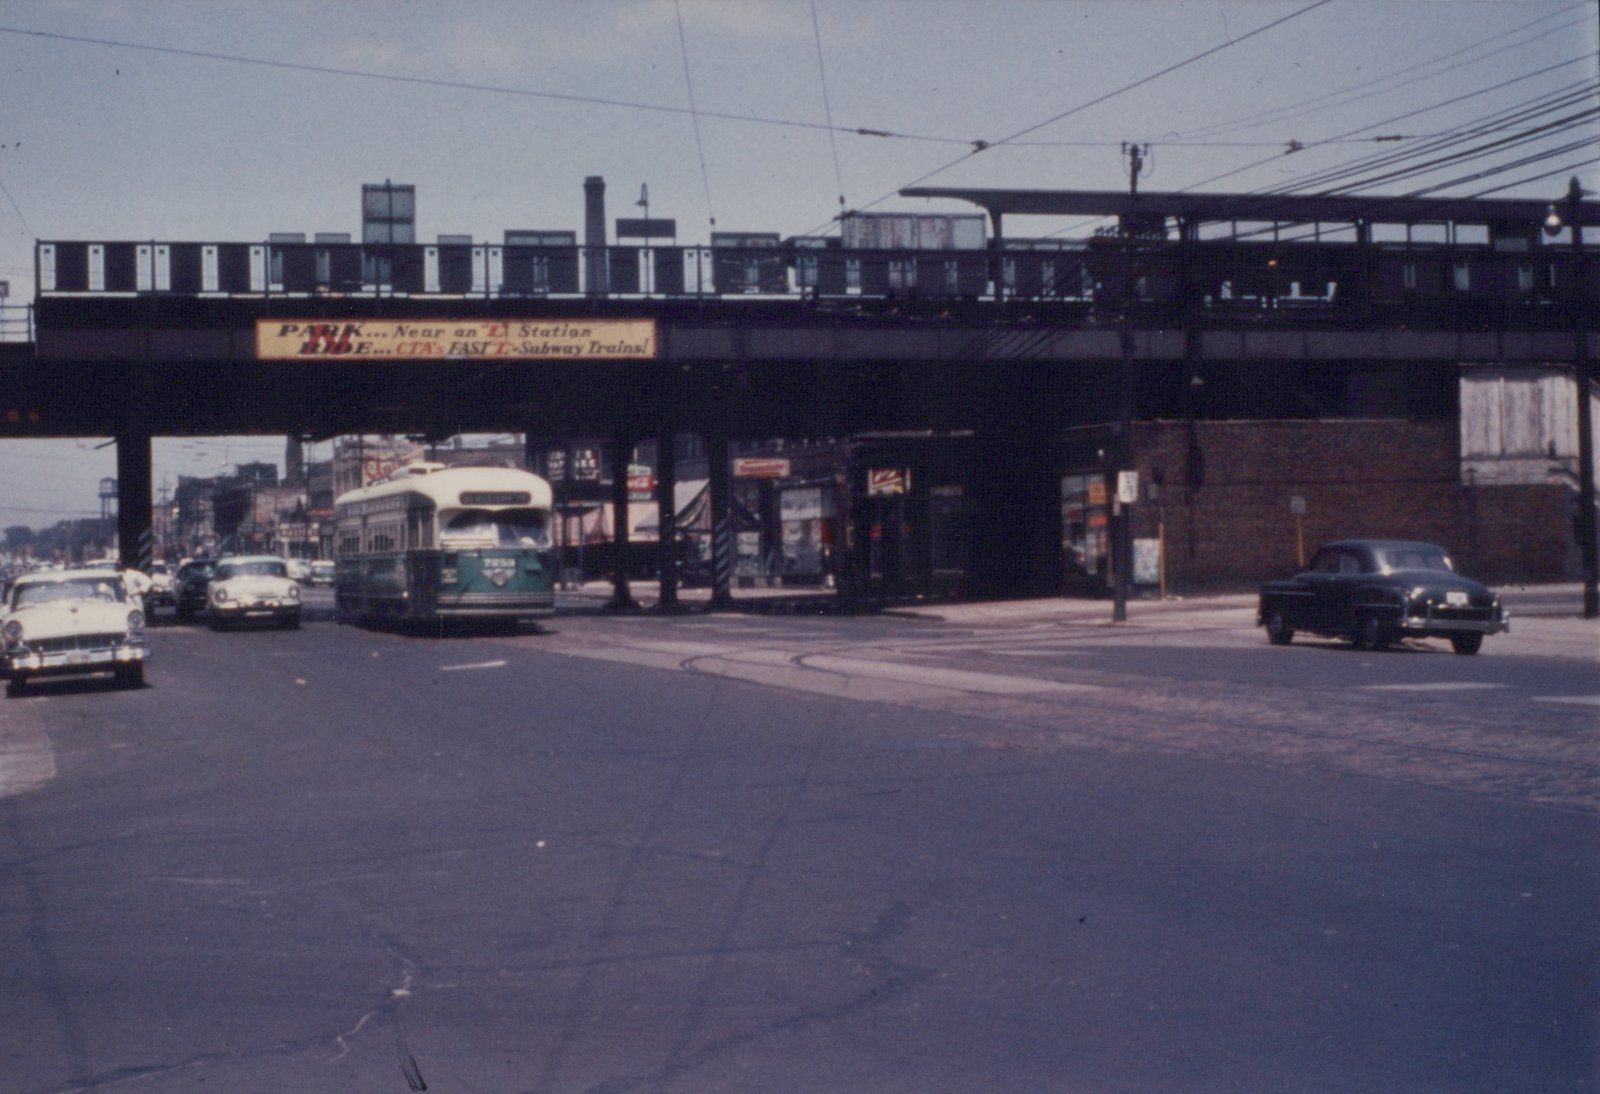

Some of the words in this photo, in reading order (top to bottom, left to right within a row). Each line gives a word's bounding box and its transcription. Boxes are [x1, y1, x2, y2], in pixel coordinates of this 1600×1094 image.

[393, 324, 446, 339] Near
[454, 328, 478, 338] an
[517, 322, 593, 338] Station
[395, 341, 446, 356] CTA's
[448, 340, 492, 355] FAST
[587, 338, 650, 355] Trains!
